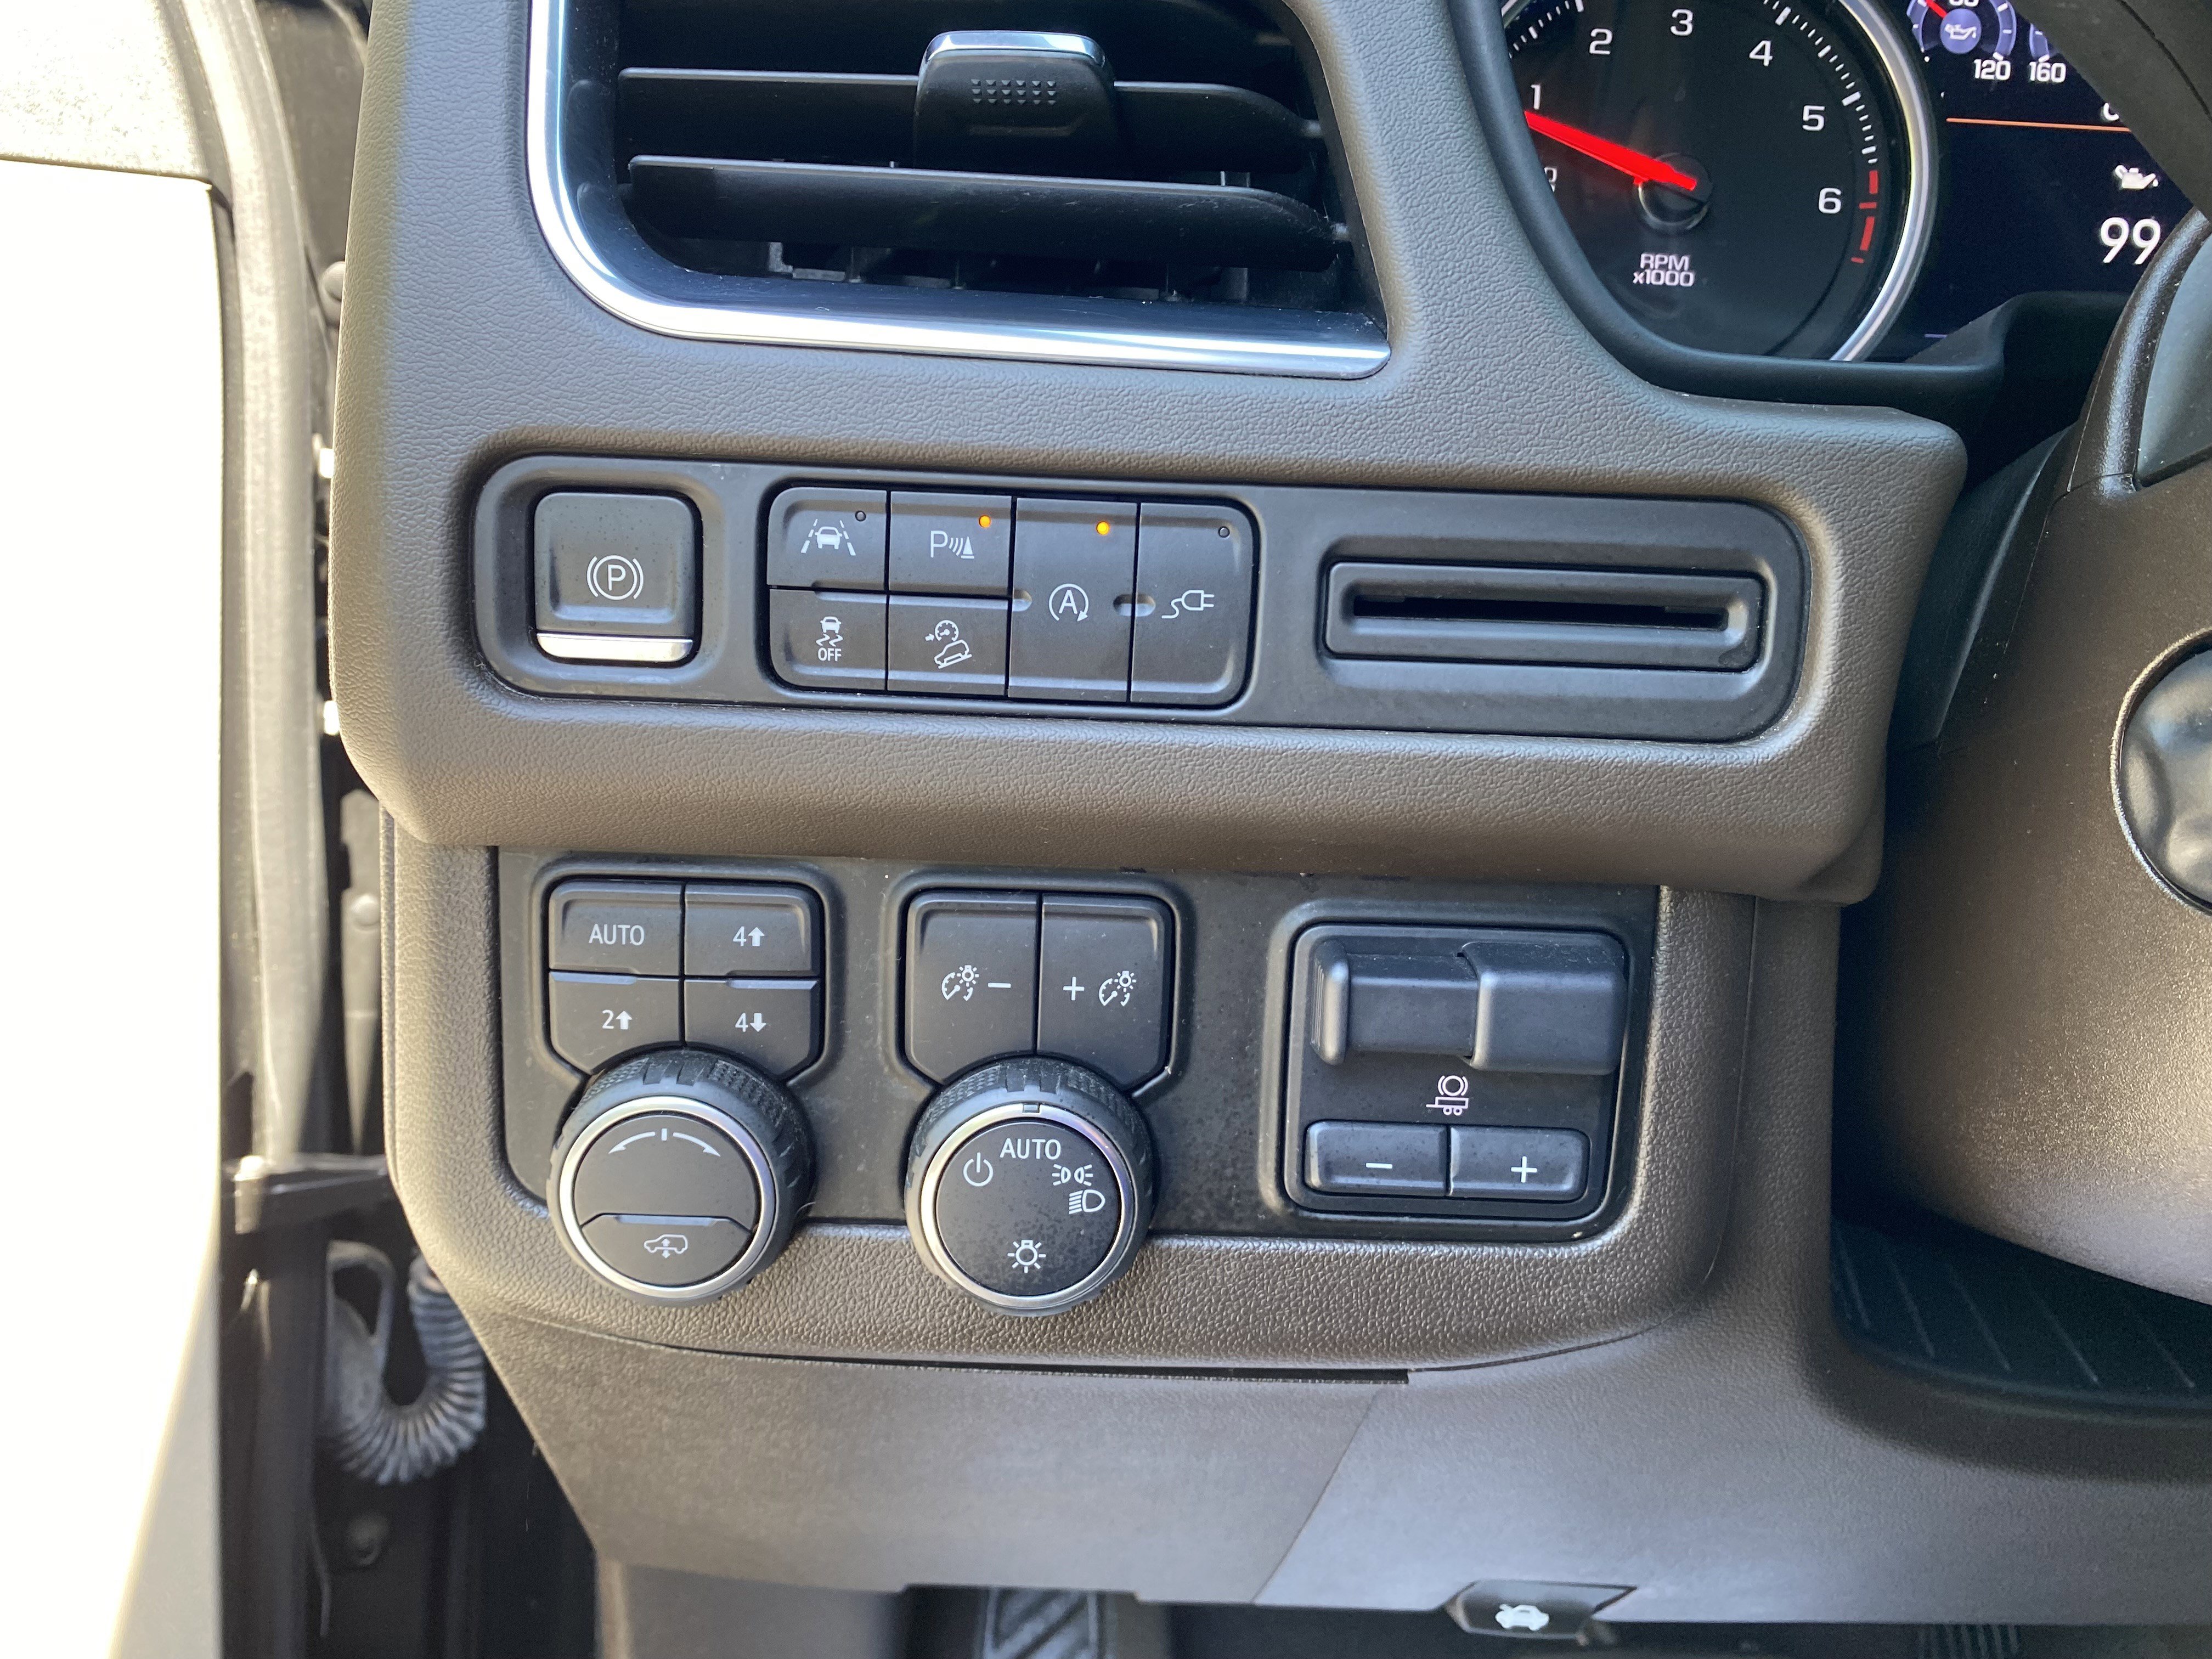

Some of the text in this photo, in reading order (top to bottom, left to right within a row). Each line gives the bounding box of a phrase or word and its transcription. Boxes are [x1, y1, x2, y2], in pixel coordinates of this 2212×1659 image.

[1670, 9, 1693, 36] 3
[1589, 28, 1612, 55] 2
[1749, 40, 1773, 66] 4
[1973, 59, 2012, 81] 120
[2029, 61, 2067, 83] 160
[1530, 84, 1541, 110] 1
[1802, 105, 1825, 131] 5
[1818, 188, 1842, 214] 6
[2100, 217, 2161, 264] 99
[1640, 253, 1689, 270] RPM
[1633, 269, 1694, 287] x1000
[607, 564, 626, 591] P
[817, 647, 842, 662] OFF
[588, 923, 645, 946] AUTO
[732, 926, 747, 946] 4
[602, 1009, 614, 1030] 2
[735, 1013, 749, 1032] 4
[1000, 1138, 1062, 1160] AUTO
